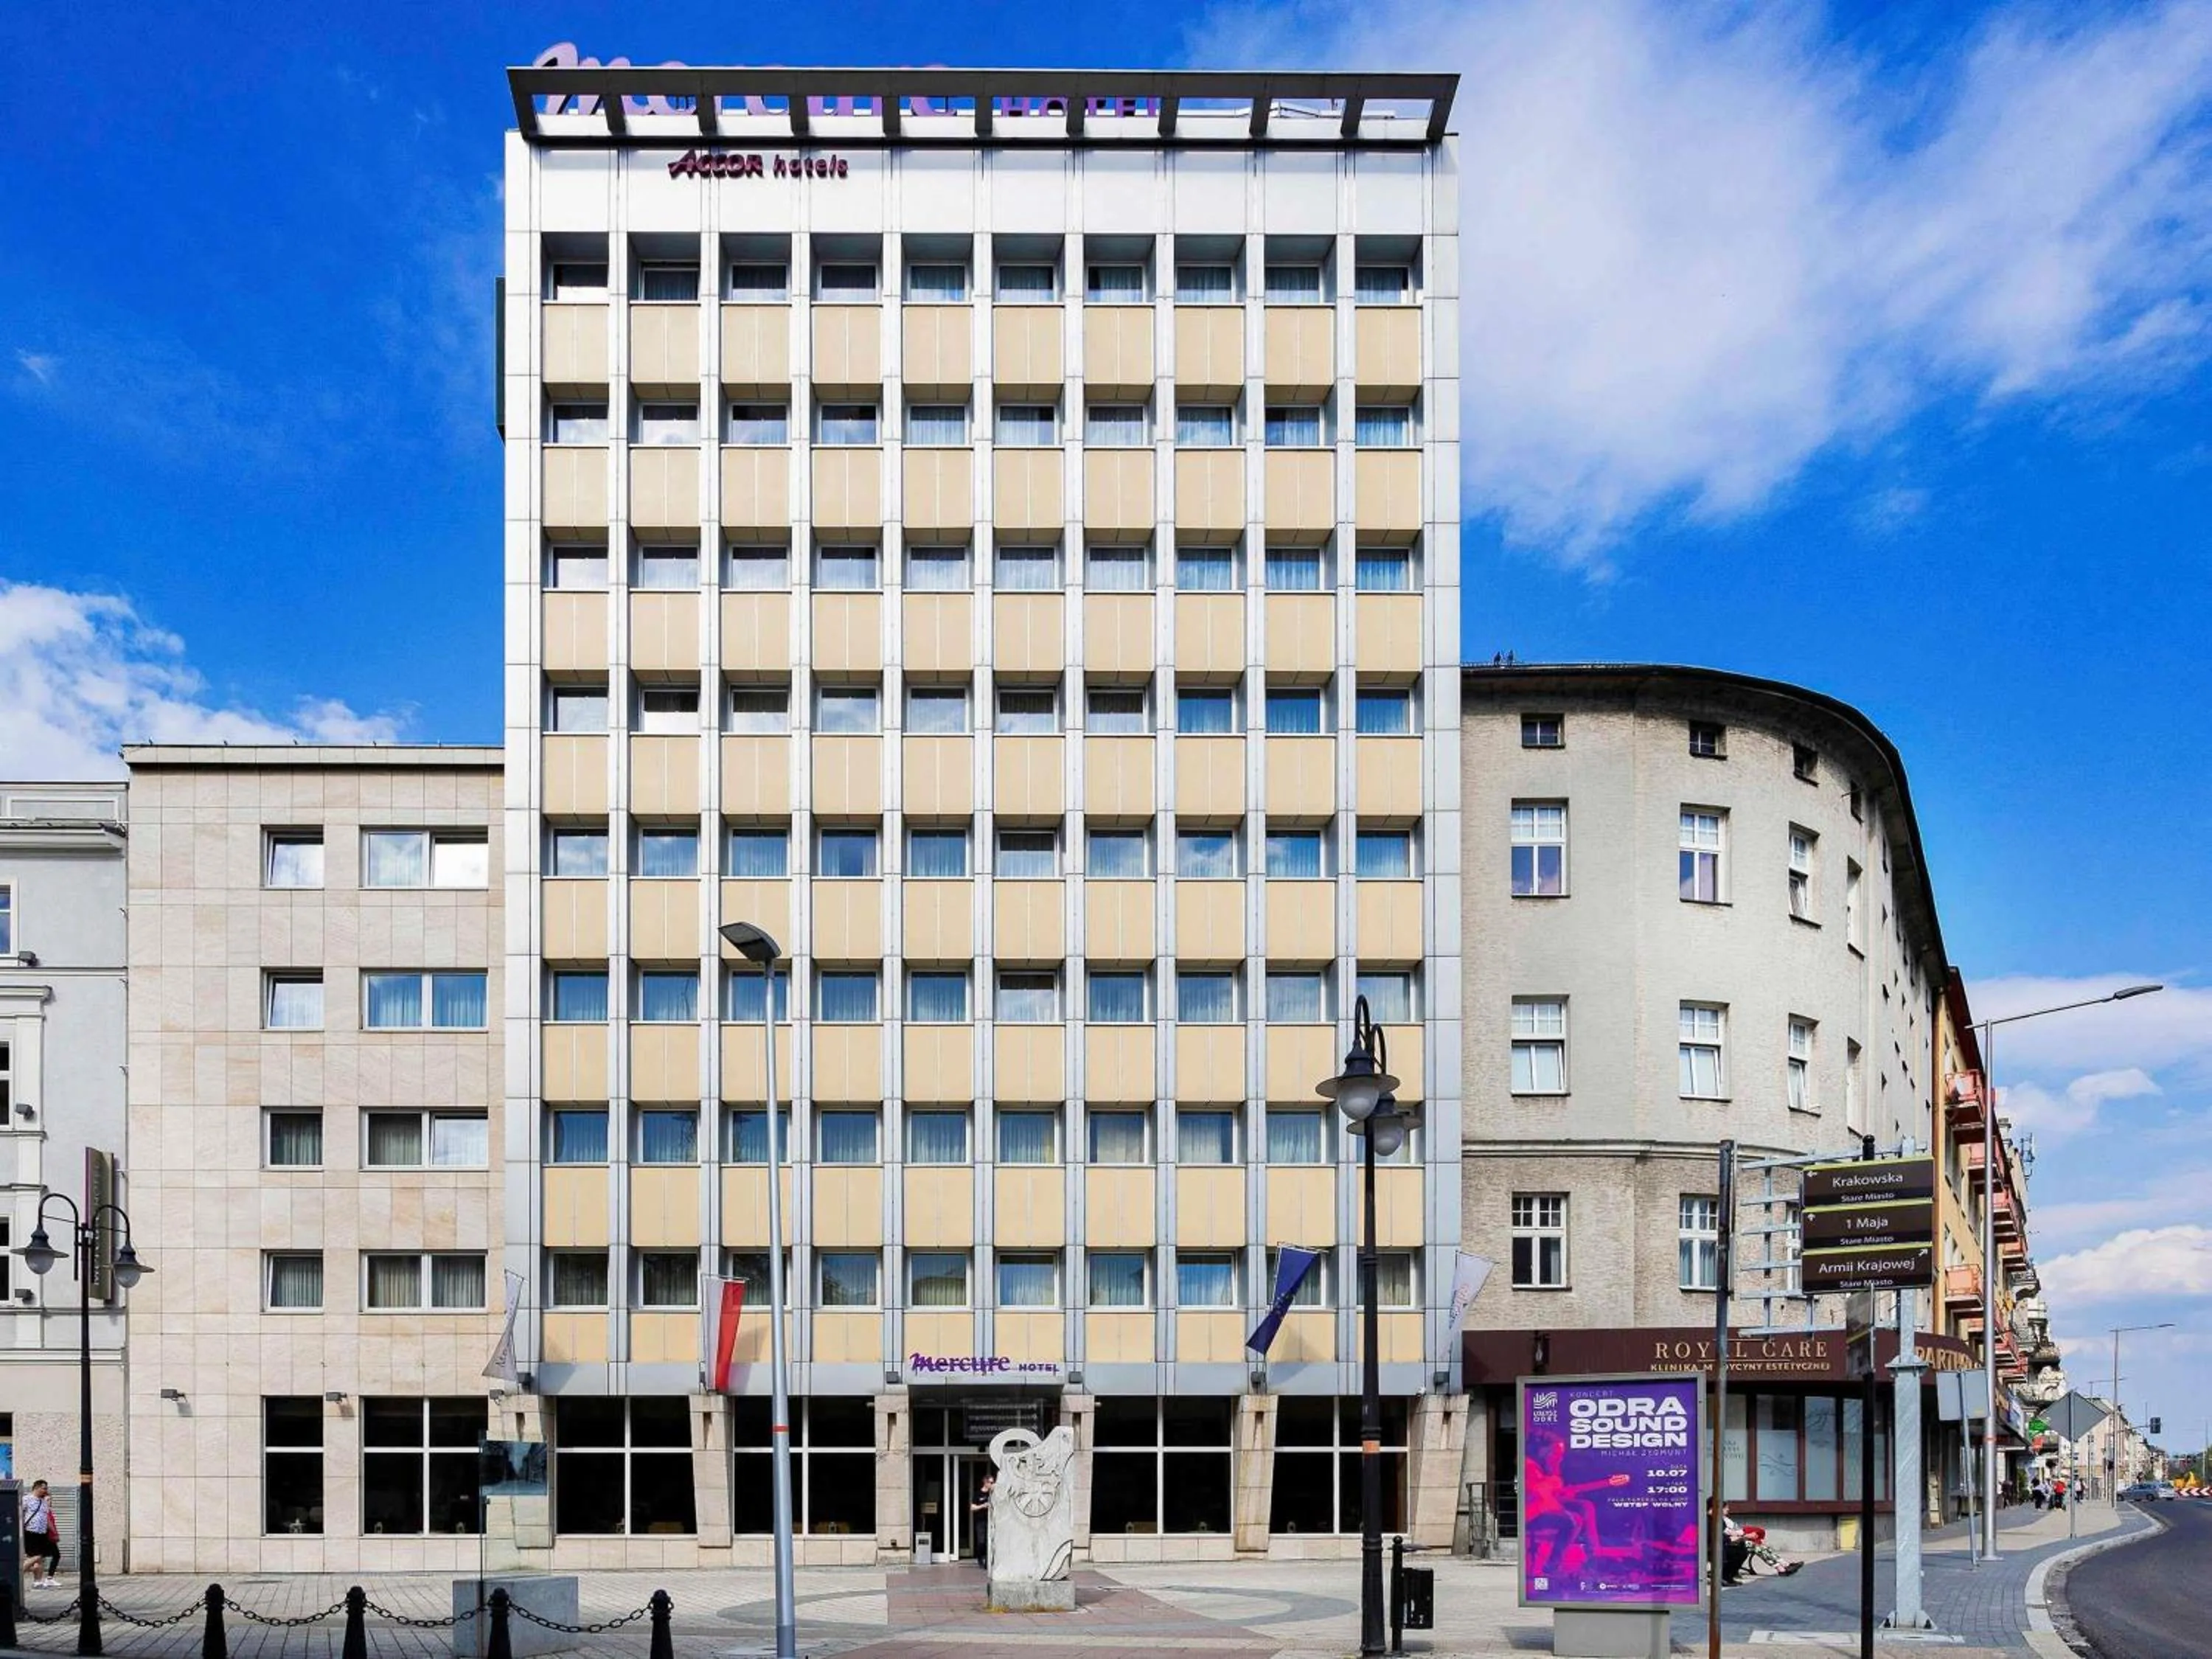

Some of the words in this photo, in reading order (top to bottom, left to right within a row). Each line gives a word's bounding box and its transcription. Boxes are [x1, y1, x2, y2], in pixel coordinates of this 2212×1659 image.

[668, 147, 763, 179] ACCOR
[773, 153, 849, 179] hotels
[1832, 1172, 1903, 1188] Krakowska
[1841, 1194, 1863, 1203] Stare
[1865, 1192, 1895, 1200] Miasto
[1846, 1220, 1851, 1229] 1
[1856, 1217, 1888, 1229] Maja
[1863, 1235, 1893, 1243] Miasto
[1819, 1262, 1853, 1274] Armii
[1857, 1257, 1916, 1271] Krajowej
[1840, 1280, 1862, 1288] Stare
[1863, 1279, 1893, 1287] Miasto
[1655, 1341, 1747, 1359] ROYL
[1762, 1341, 1827, 1358] CARE
[909, 1352, 1010, 1376] Mercure
[1018, 1363, 1060, 1372] HOTEL
[1650, 1363, 1698, 1371] KLINIKA
[1703, 1363, 1761, 1371] MYCYNY
[1570, 1397, 1687, 1417] ODRA
[1570, 1416, 1688, 1433] SOUND
[1570, 1432, 1688, 1449] DESIGN
[1647, 1470, 1688, 1478] 10.07
[1647, 1486, 1688, 1494] 17:00
